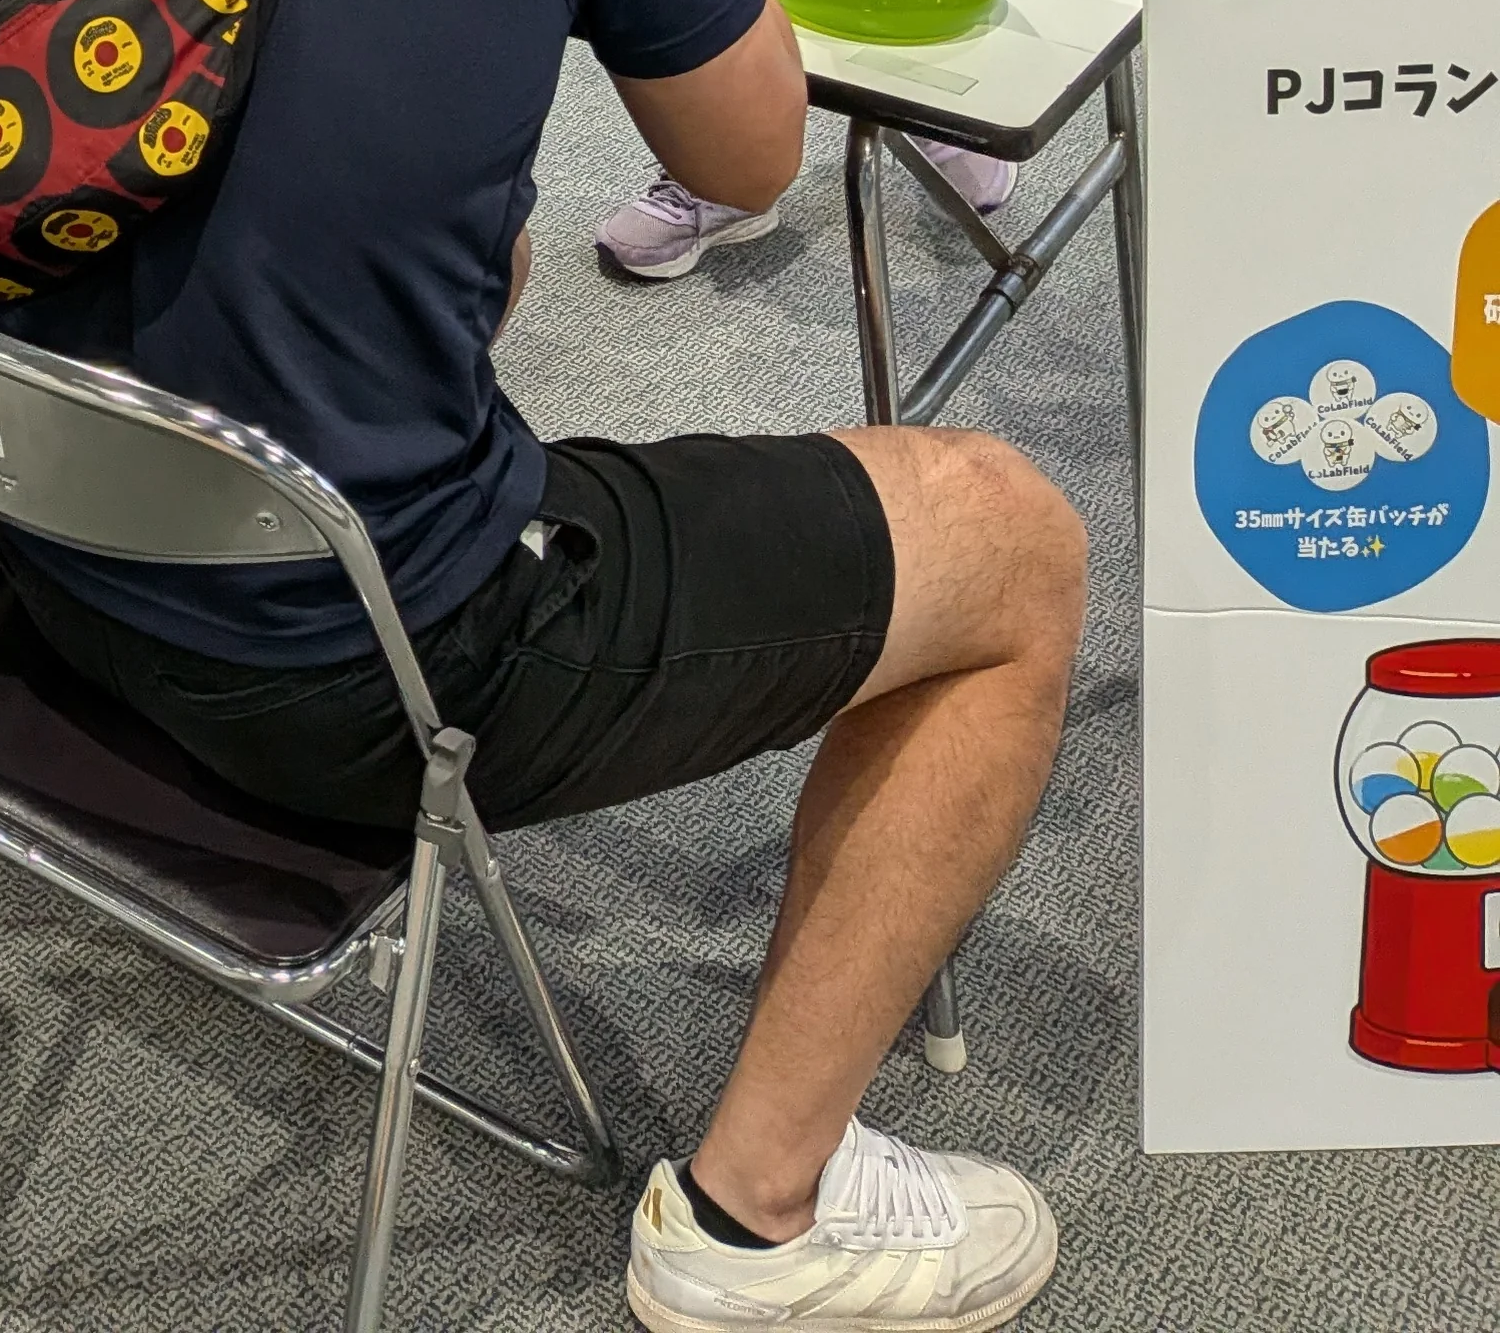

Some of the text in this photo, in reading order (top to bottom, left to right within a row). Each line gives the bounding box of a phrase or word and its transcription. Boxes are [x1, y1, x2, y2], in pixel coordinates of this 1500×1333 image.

[1266, 63, 1499, 118] PJコラン
[1317, 397, 1373, 414] CoLabField
[1365, 416, 1414, 462] CoLabField
[1297, 536, 1360, 559] 当たる
